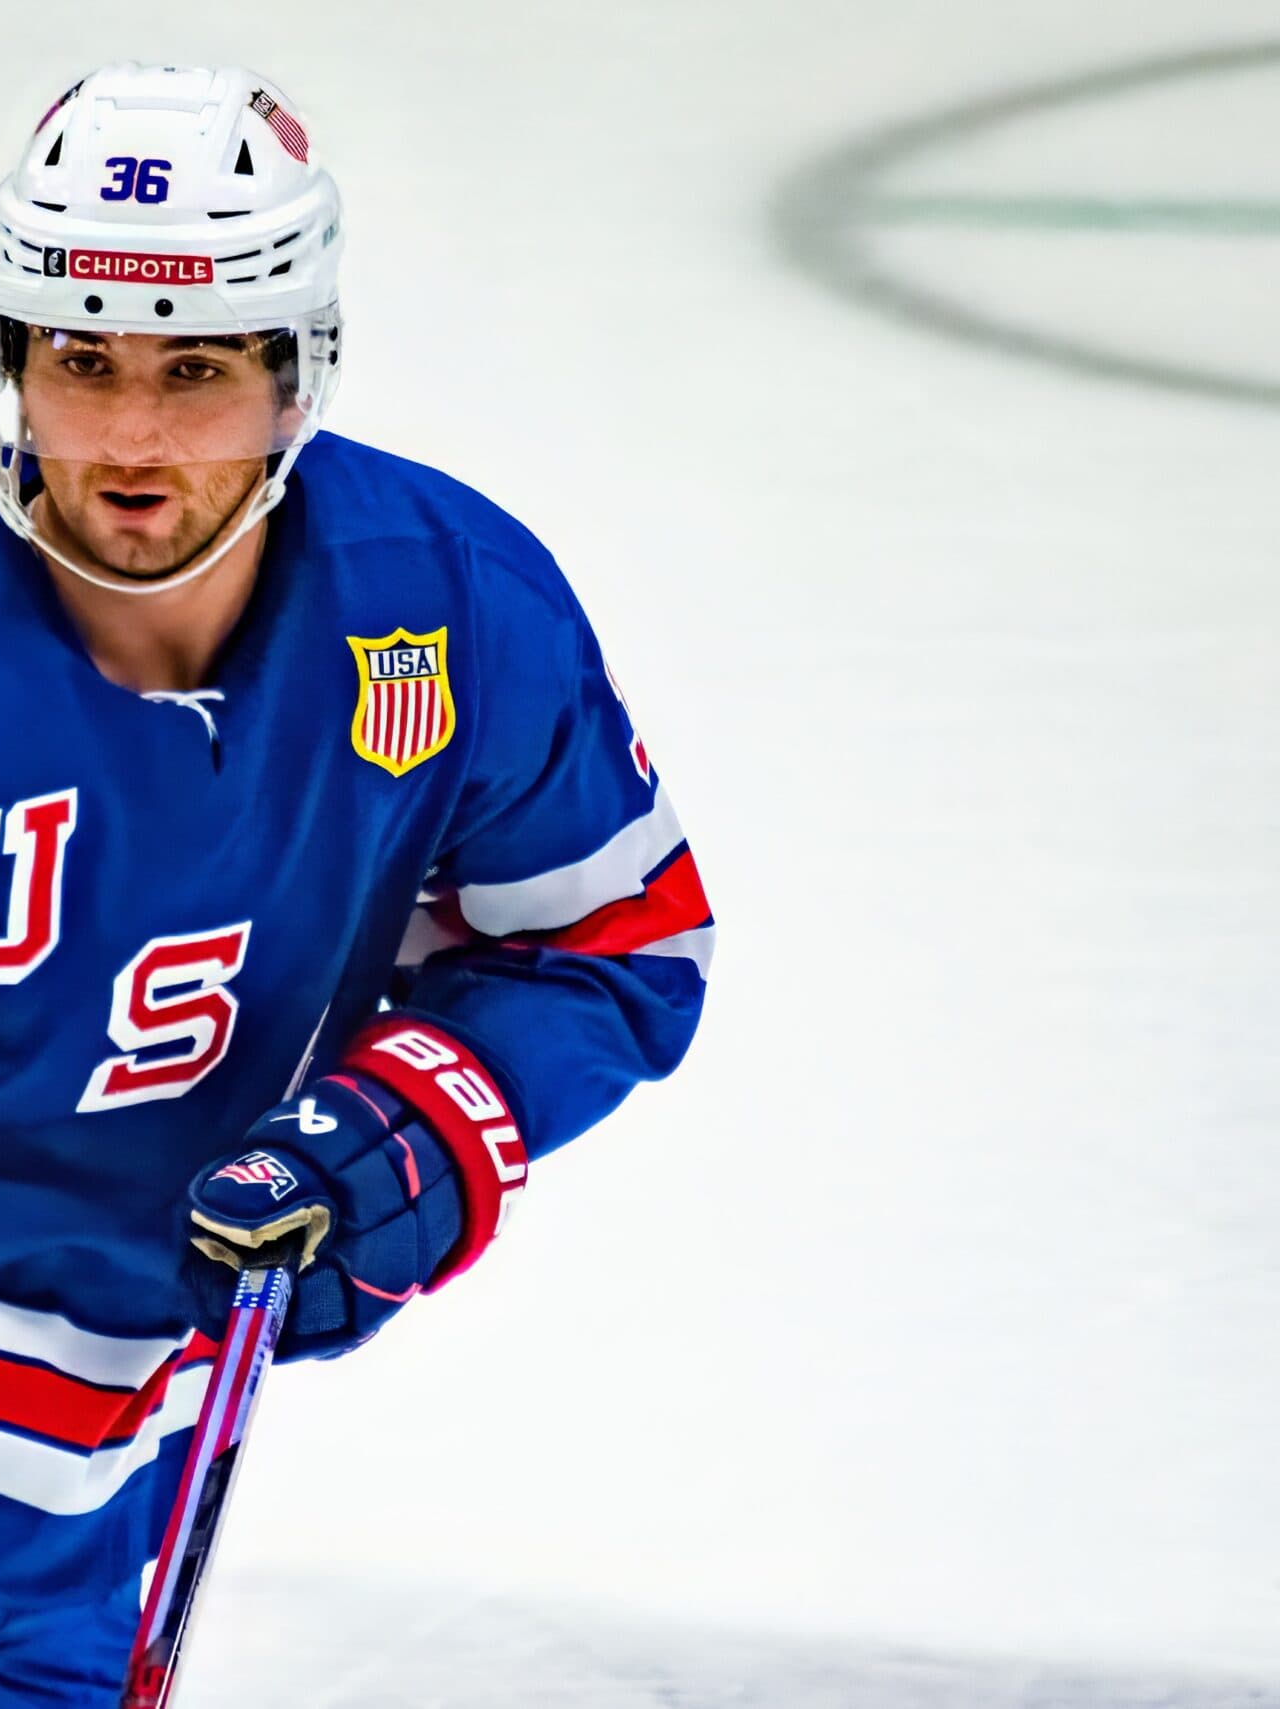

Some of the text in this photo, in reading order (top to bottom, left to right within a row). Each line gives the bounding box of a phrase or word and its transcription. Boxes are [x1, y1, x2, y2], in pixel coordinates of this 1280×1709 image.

[99, 156, 172, 204] 36
[74, 255, 208, 280] CHIPOTLE
[378, 647, 433, 676] USA
